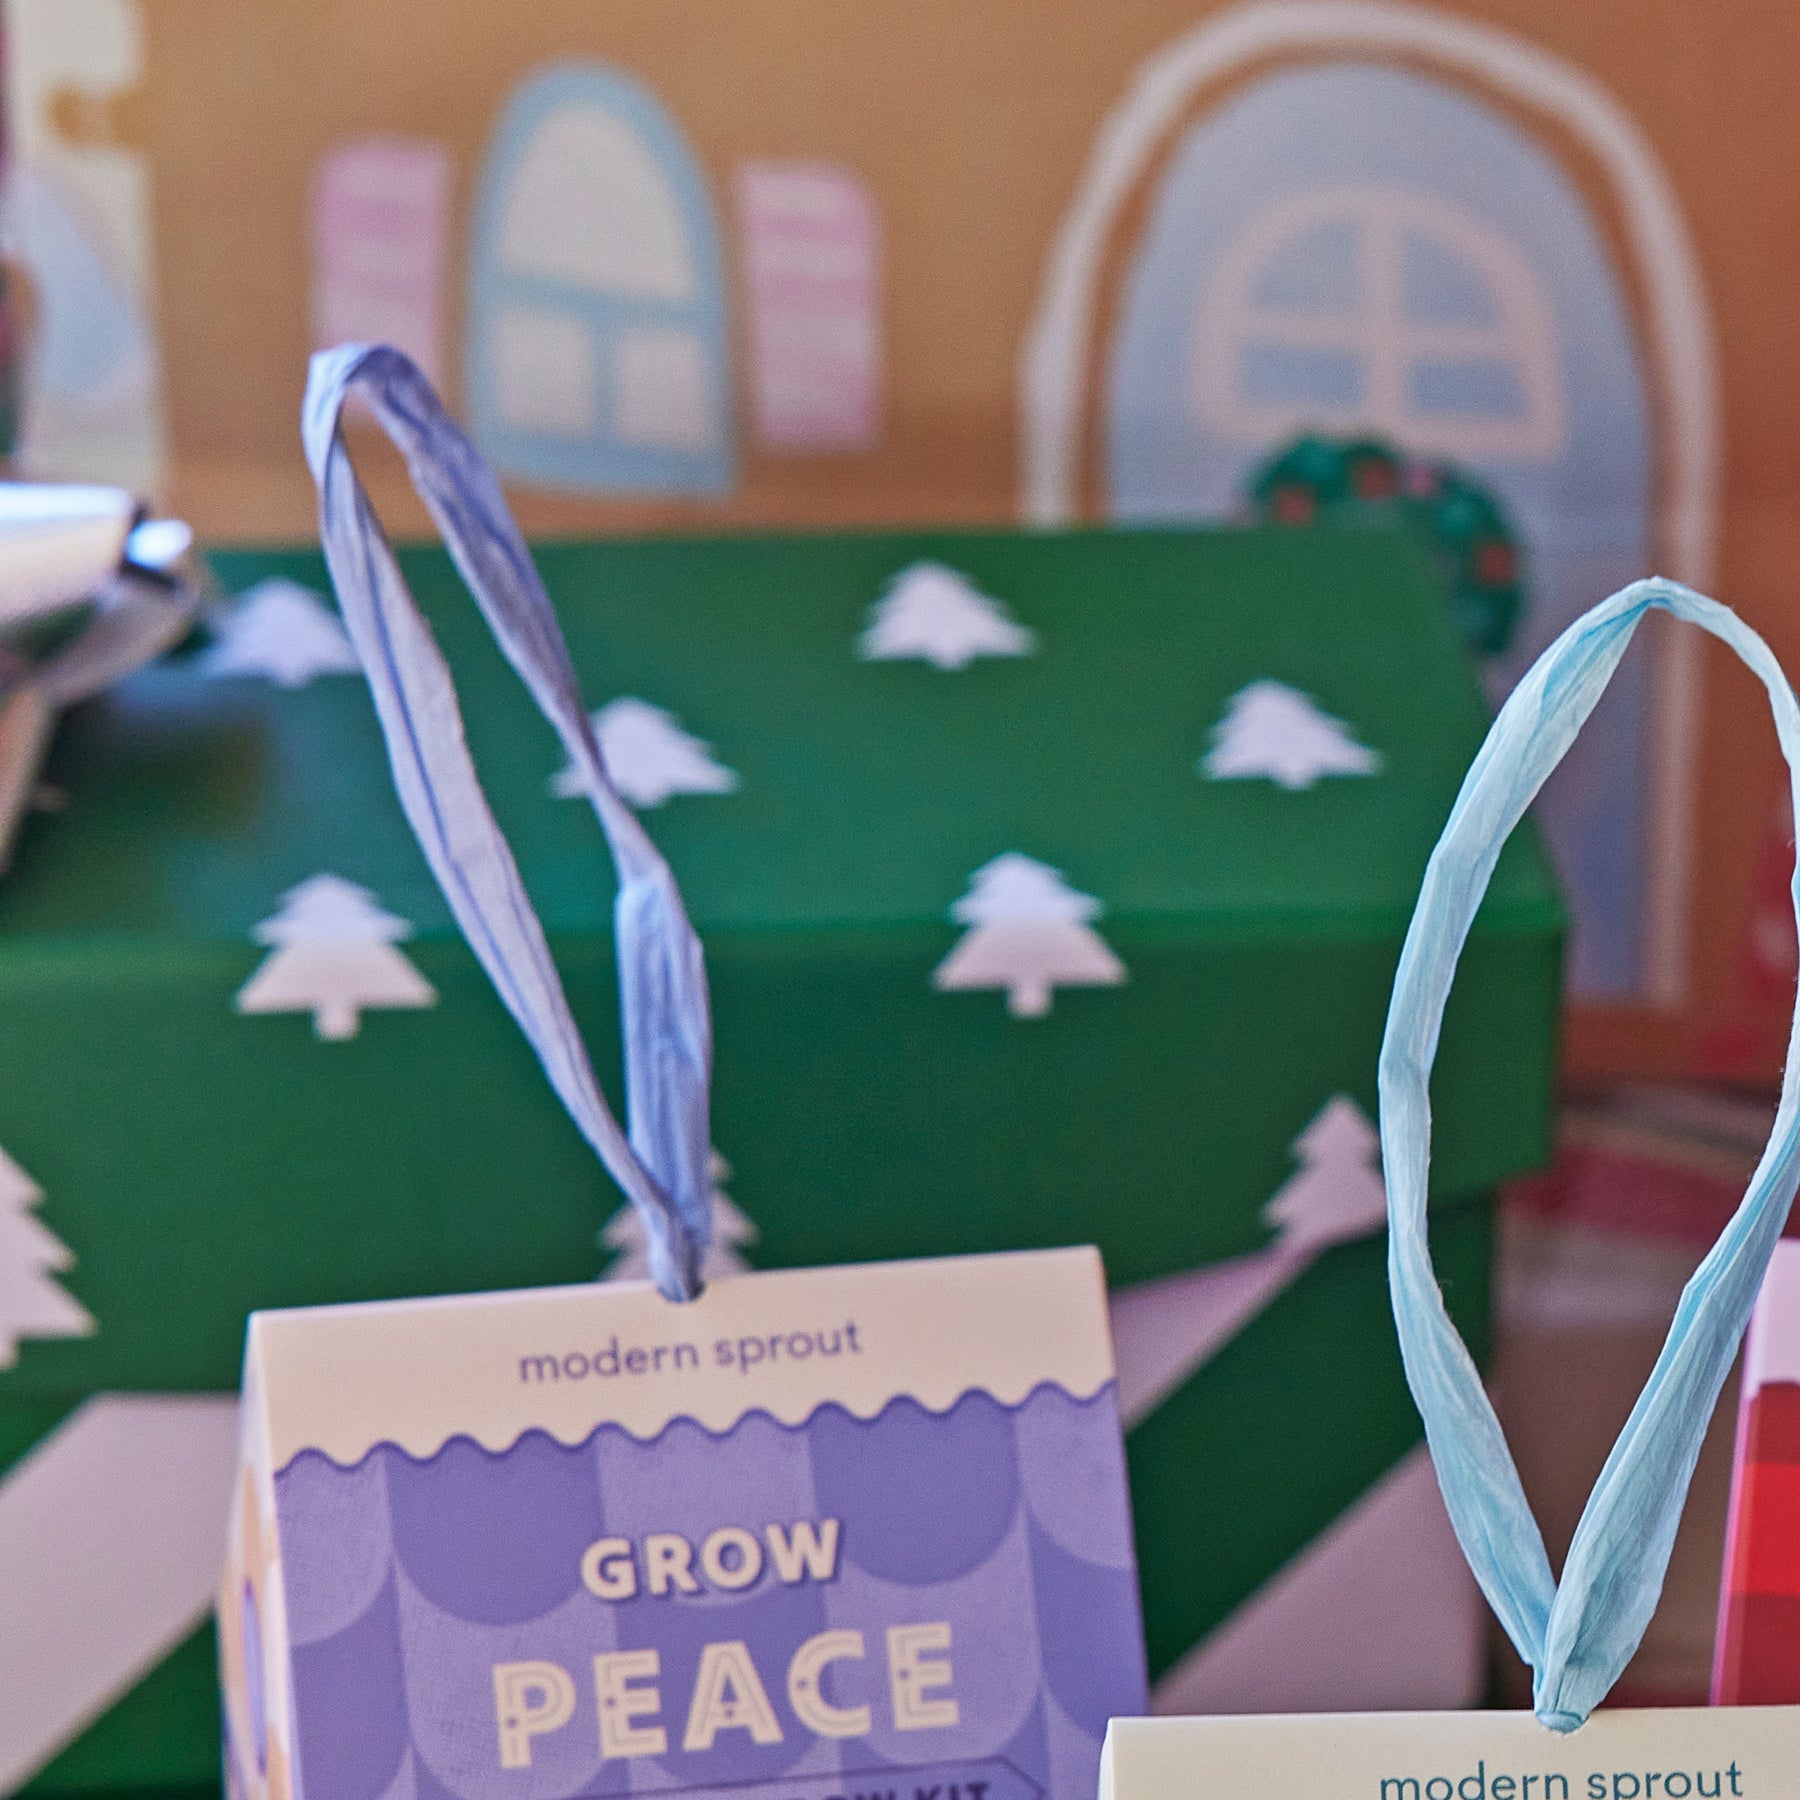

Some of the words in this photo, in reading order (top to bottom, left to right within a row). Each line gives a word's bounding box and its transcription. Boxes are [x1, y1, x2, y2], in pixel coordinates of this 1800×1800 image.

[519, 1336, 699, 1384] modern
[716, 1320, 863, 1374] sprout
[580, 1519, 843, 1600] GROW
[491, 1622, 960, 1769] PEACE
